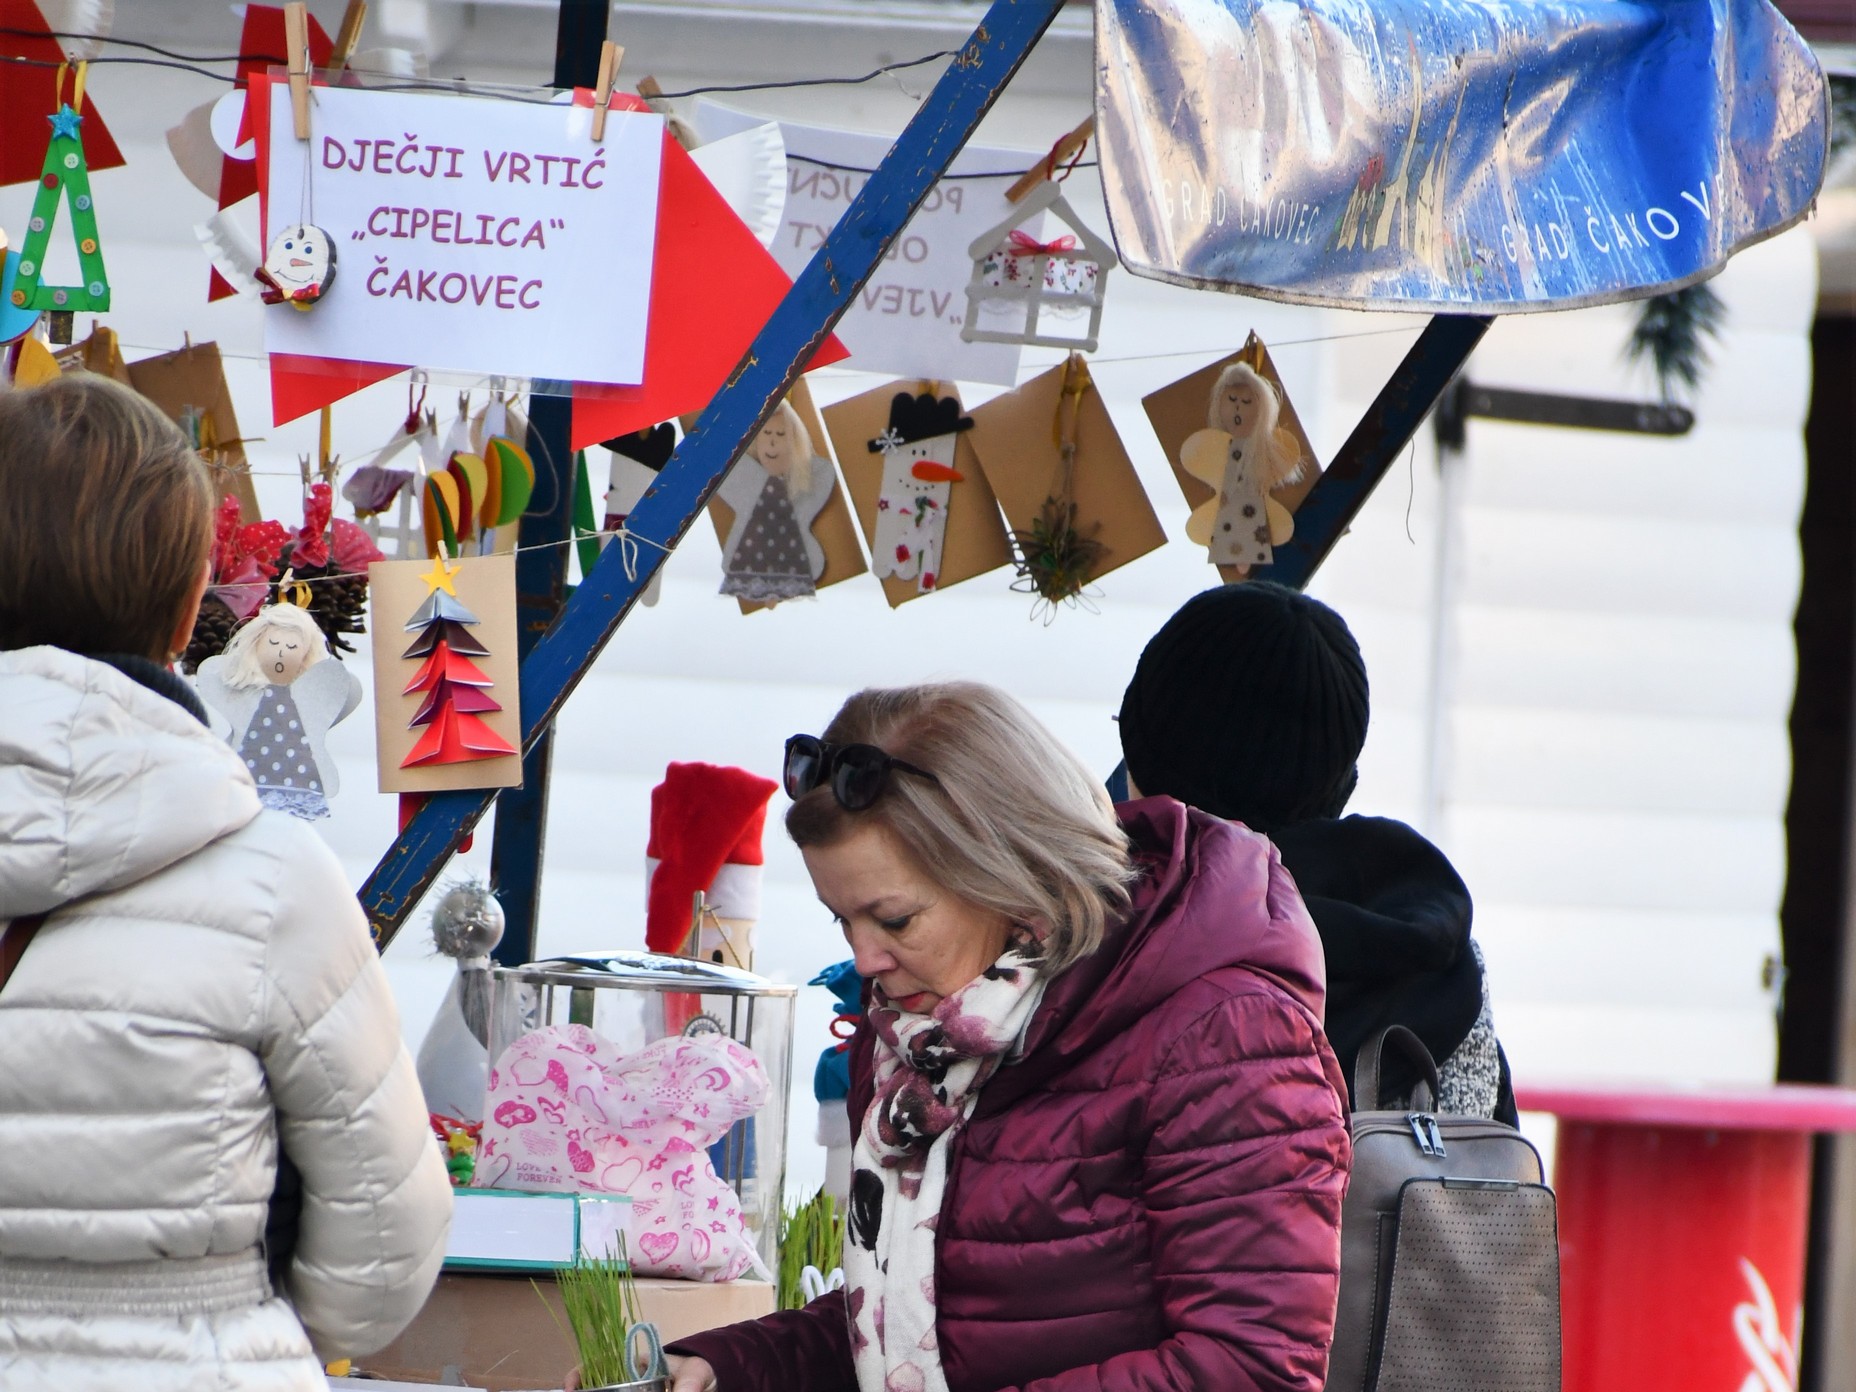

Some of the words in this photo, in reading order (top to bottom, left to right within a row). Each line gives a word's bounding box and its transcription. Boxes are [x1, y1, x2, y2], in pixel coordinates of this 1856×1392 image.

[322, 132, 465, 178] DJEČJI
[483, 147, 607, 190] VRTIĆ
[1161, 178, 1227, 227] GRAD
[1501, 221, 1570, 264] GRAD
[366, 257, 543, 310] ČAKOVEC
